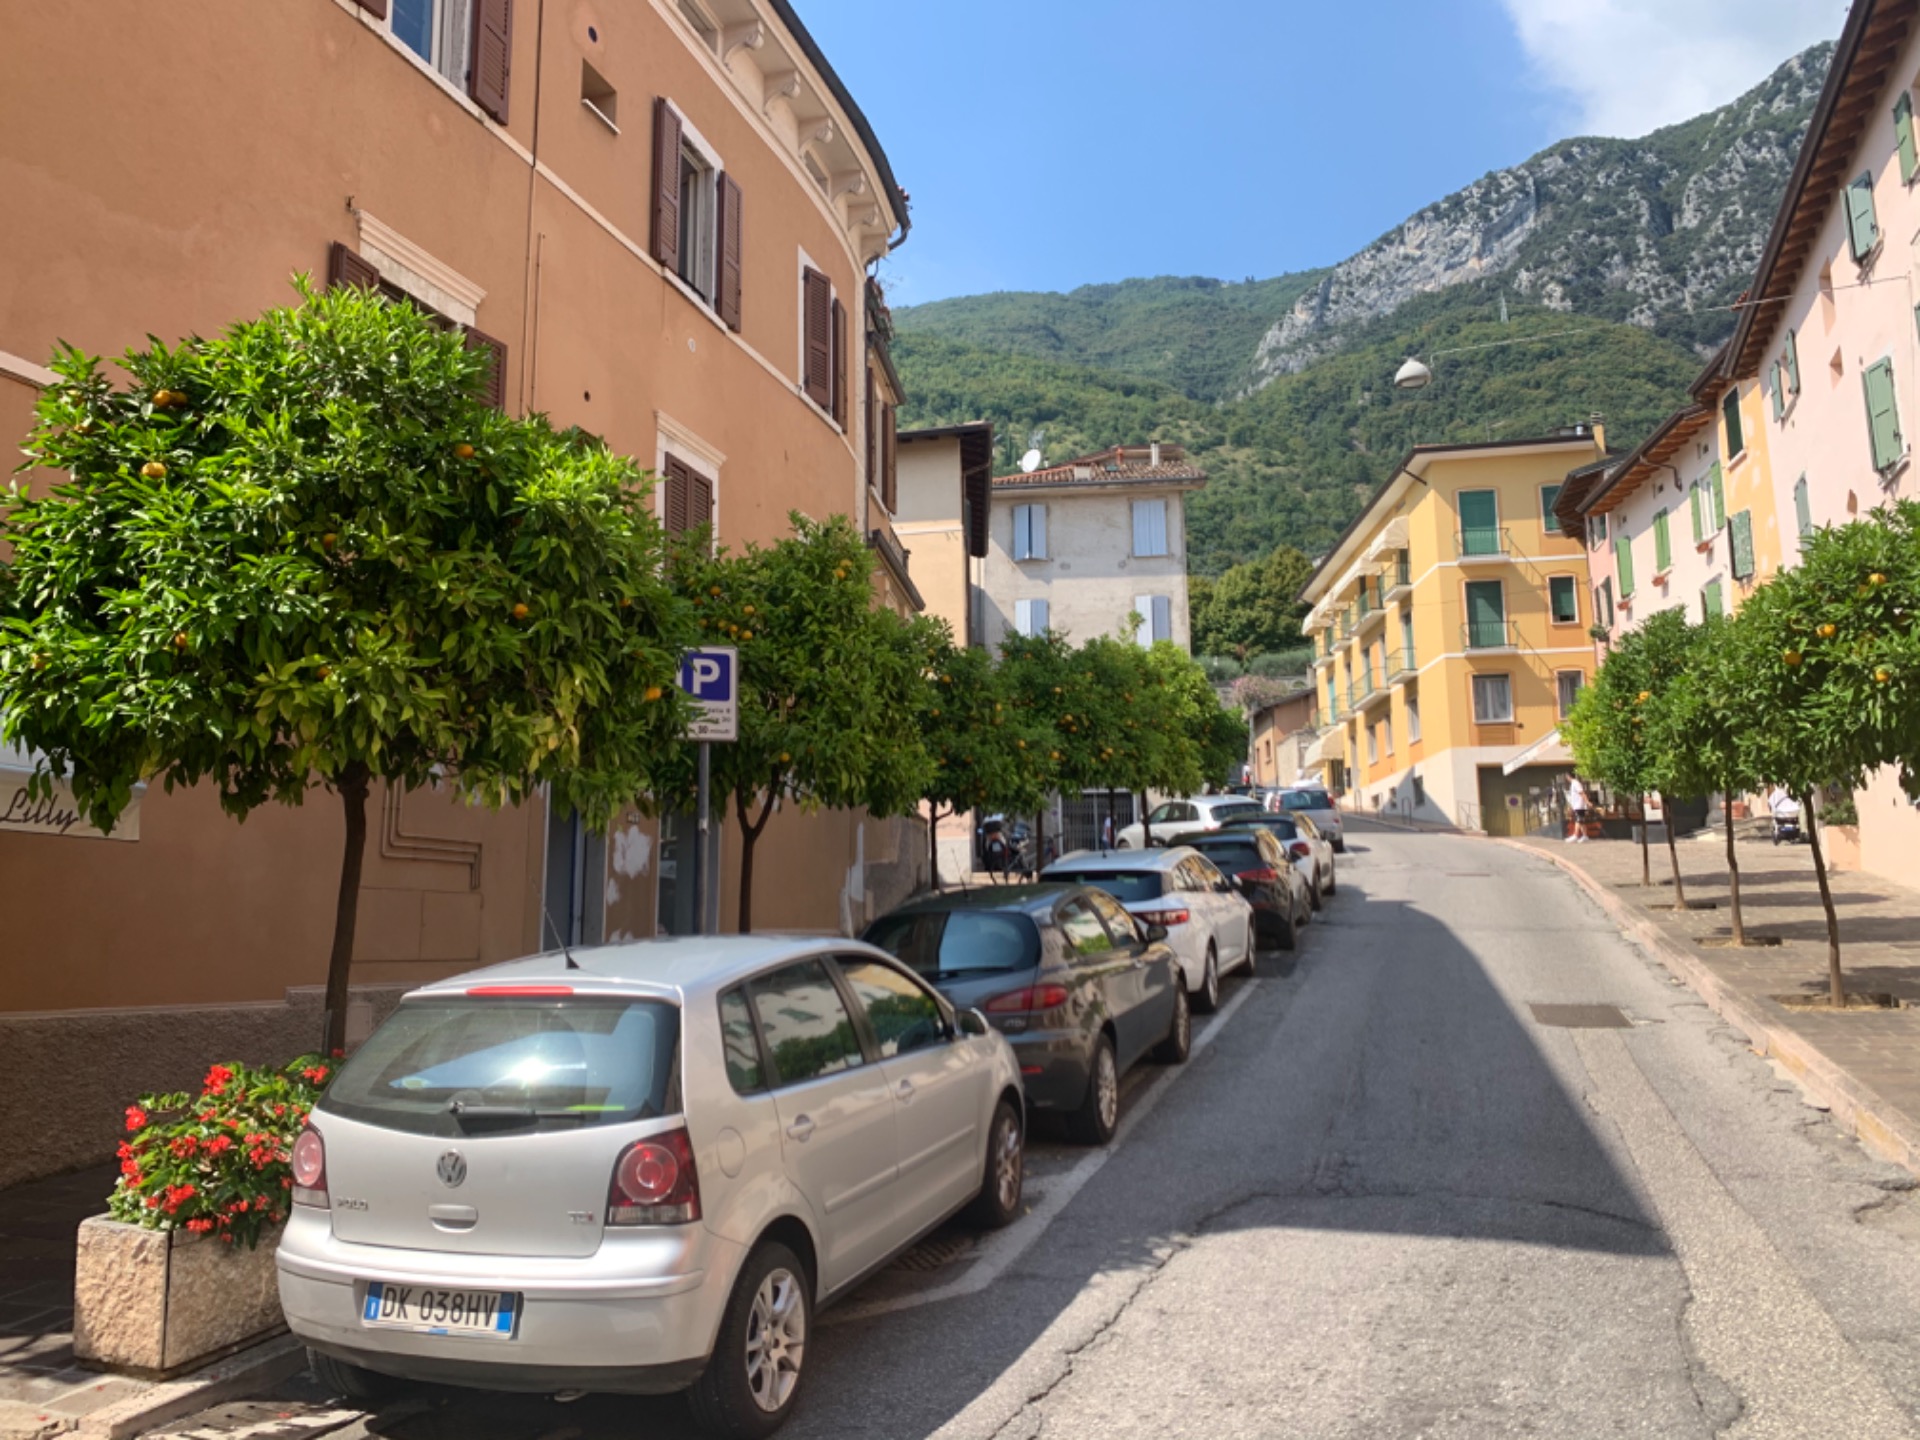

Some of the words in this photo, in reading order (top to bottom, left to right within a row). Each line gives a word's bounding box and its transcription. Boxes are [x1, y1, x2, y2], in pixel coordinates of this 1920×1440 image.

[693, 658, 720, 694] P
[0, 785, 79, 835] Lilly
[382, 1287, 412, 1319] DK
[420, 1290, 497, 1327] 038HV
